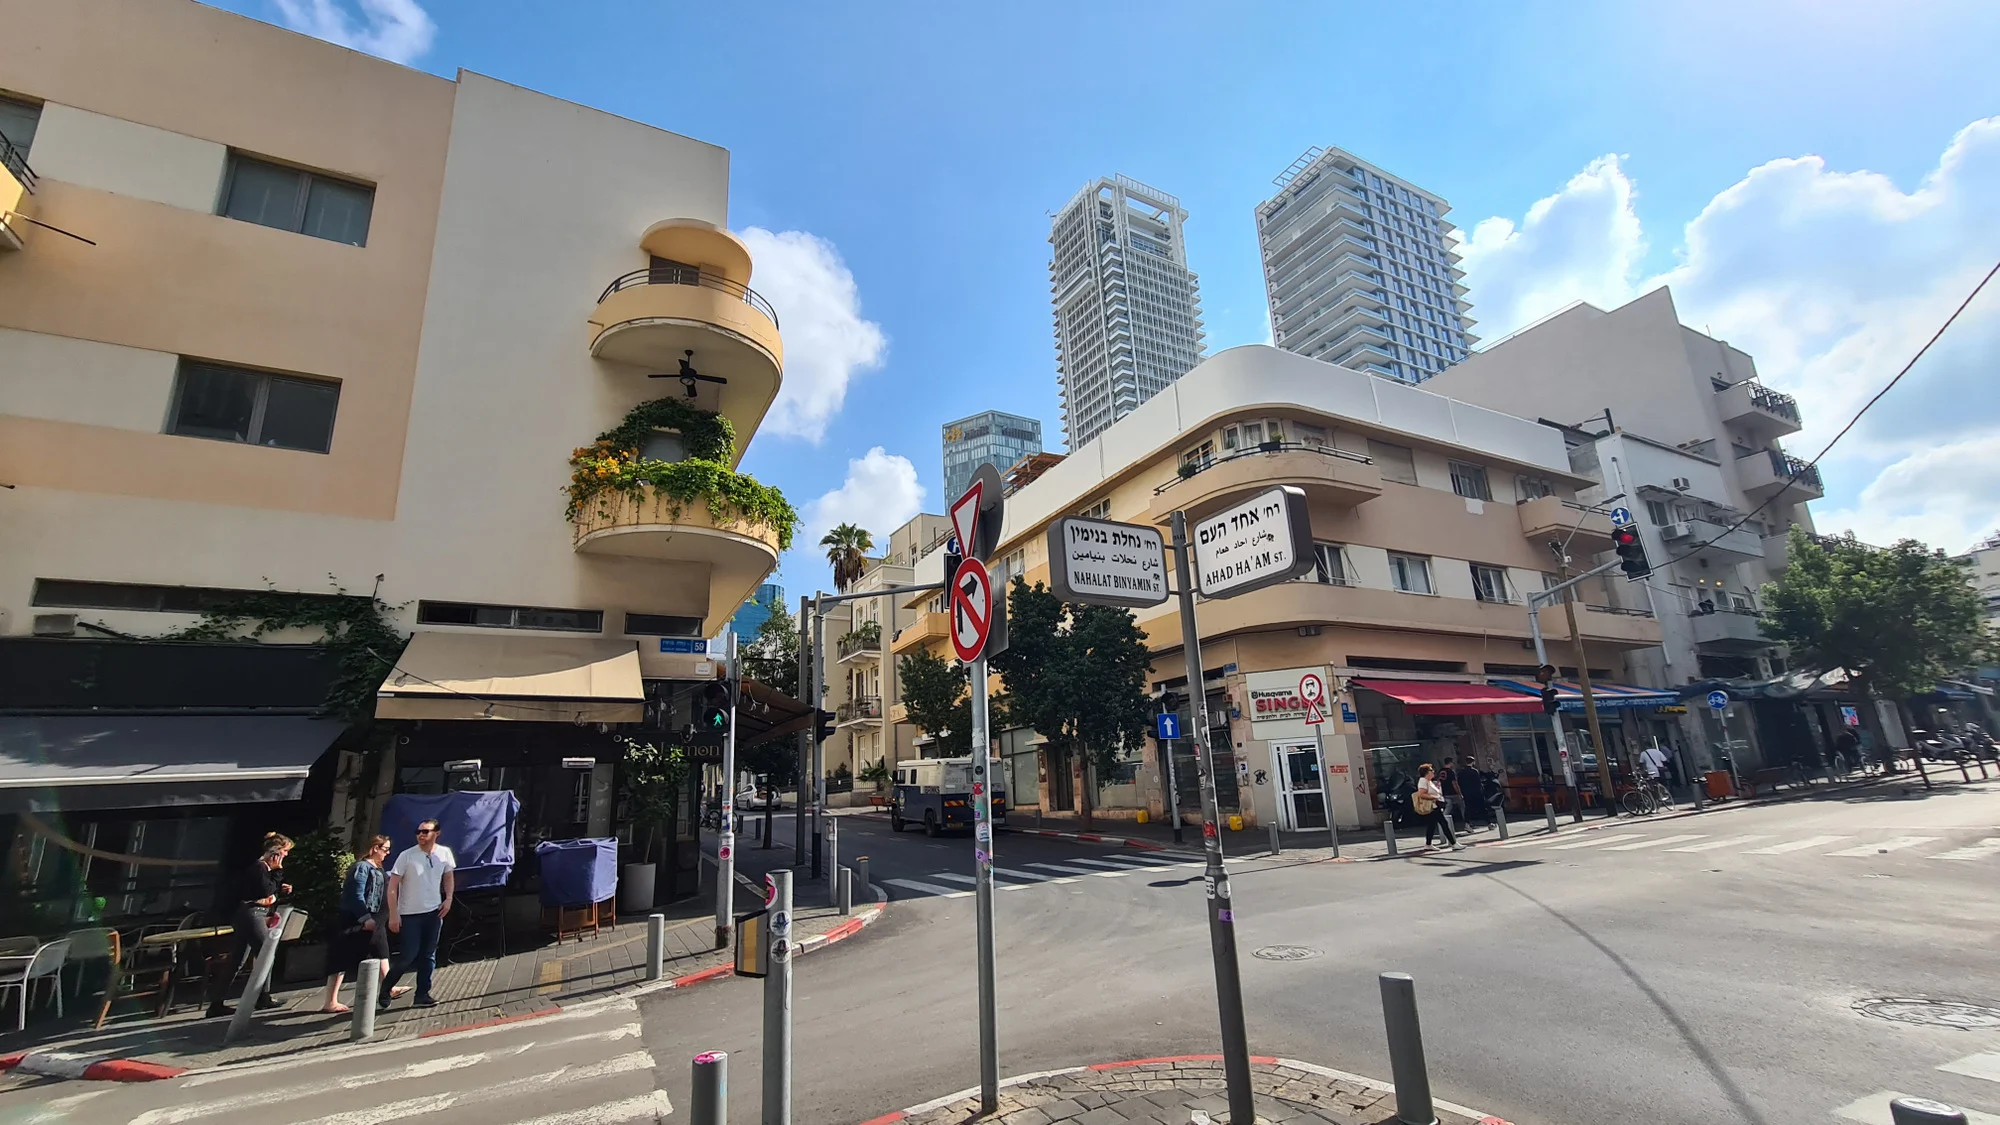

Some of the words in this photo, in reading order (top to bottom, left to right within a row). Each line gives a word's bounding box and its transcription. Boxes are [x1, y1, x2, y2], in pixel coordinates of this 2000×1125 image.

[1231, 507, 1260, 532] אחד
[1070, 525, 1108, 544] בנימין
[1112, 530, 1141, 549] נחלת
[1200, 522, 1227, 545] העם
[1252, 529, 1267, 547] شارع
[1072, 550, 1106, 563] بنيامين
[1111, 553, 1137, 565] نحلات
[1142, 558, 1159, 571] شارع
[1205, 565, 1234, 587] AHAD
[1235, 551, 1271, 576] HA'AM
[1274, 551, 1287, 563] ST.
[1073, 571, 1112, 588] NAHALAT
[1113, 575, 1152, 592] BINYAMIN
[1152, 583, 1162, 593] ST.
[694, 642, 705, 652] 59
[1258, 690, 1293, 699] Husqvarna
